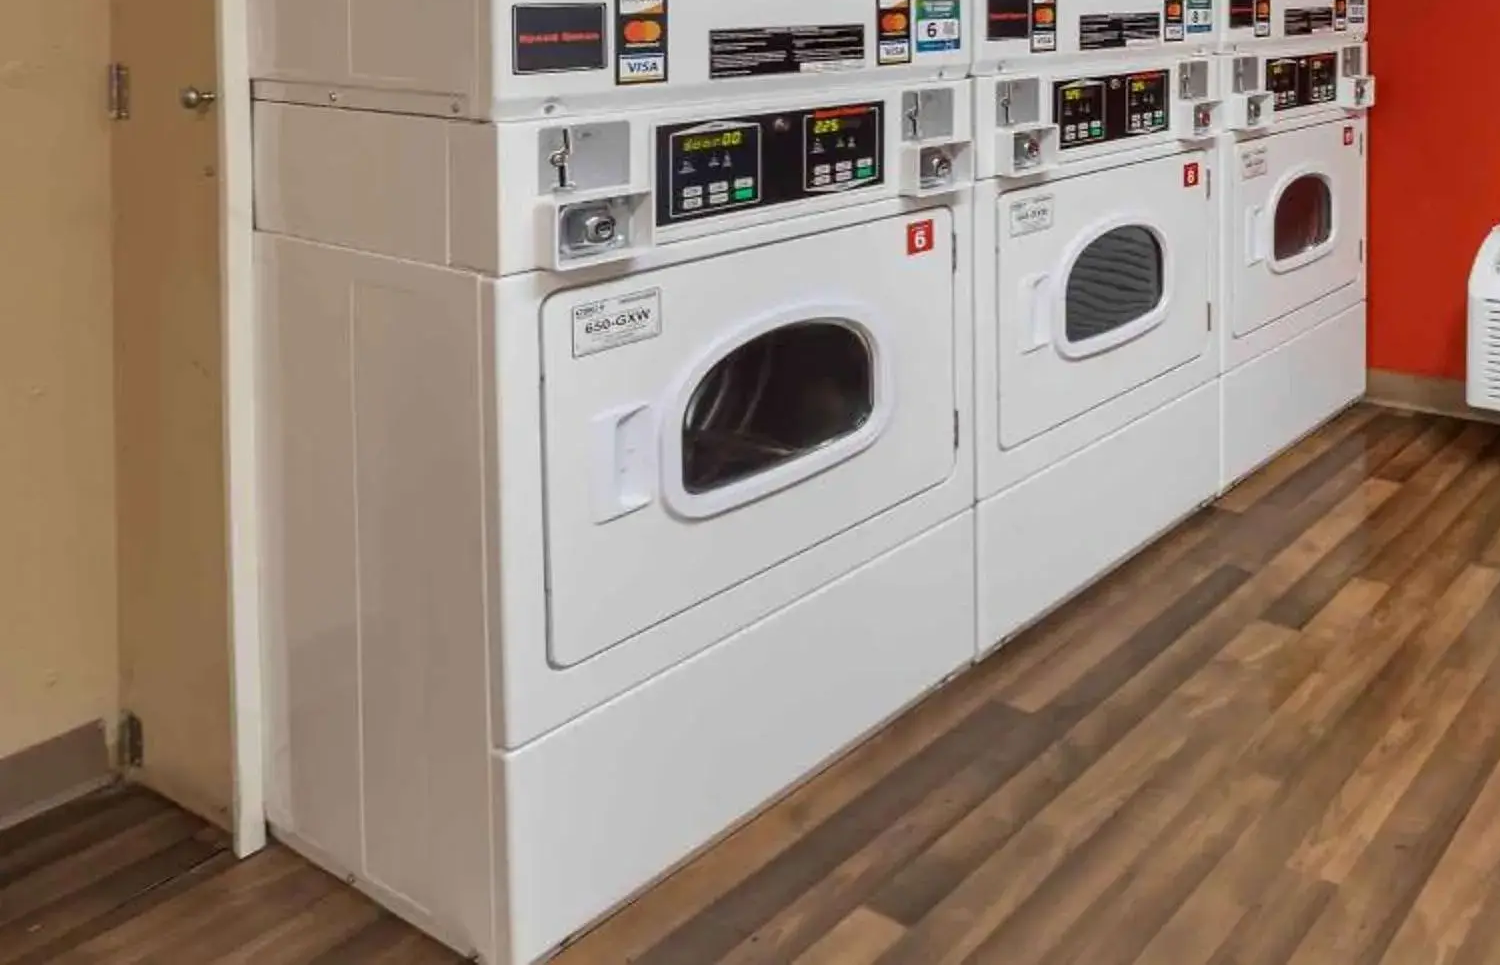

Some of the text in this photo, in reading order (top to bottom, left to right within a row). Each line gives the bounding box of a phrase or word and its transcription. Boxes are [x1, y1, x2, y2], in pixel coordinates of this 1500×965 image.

[926, 22, 937, 38] 6
[626, 61, 659, 73] VISA
[914, 229, 926, 249] 6
[584, 307, 652, 334] 650-GXW
